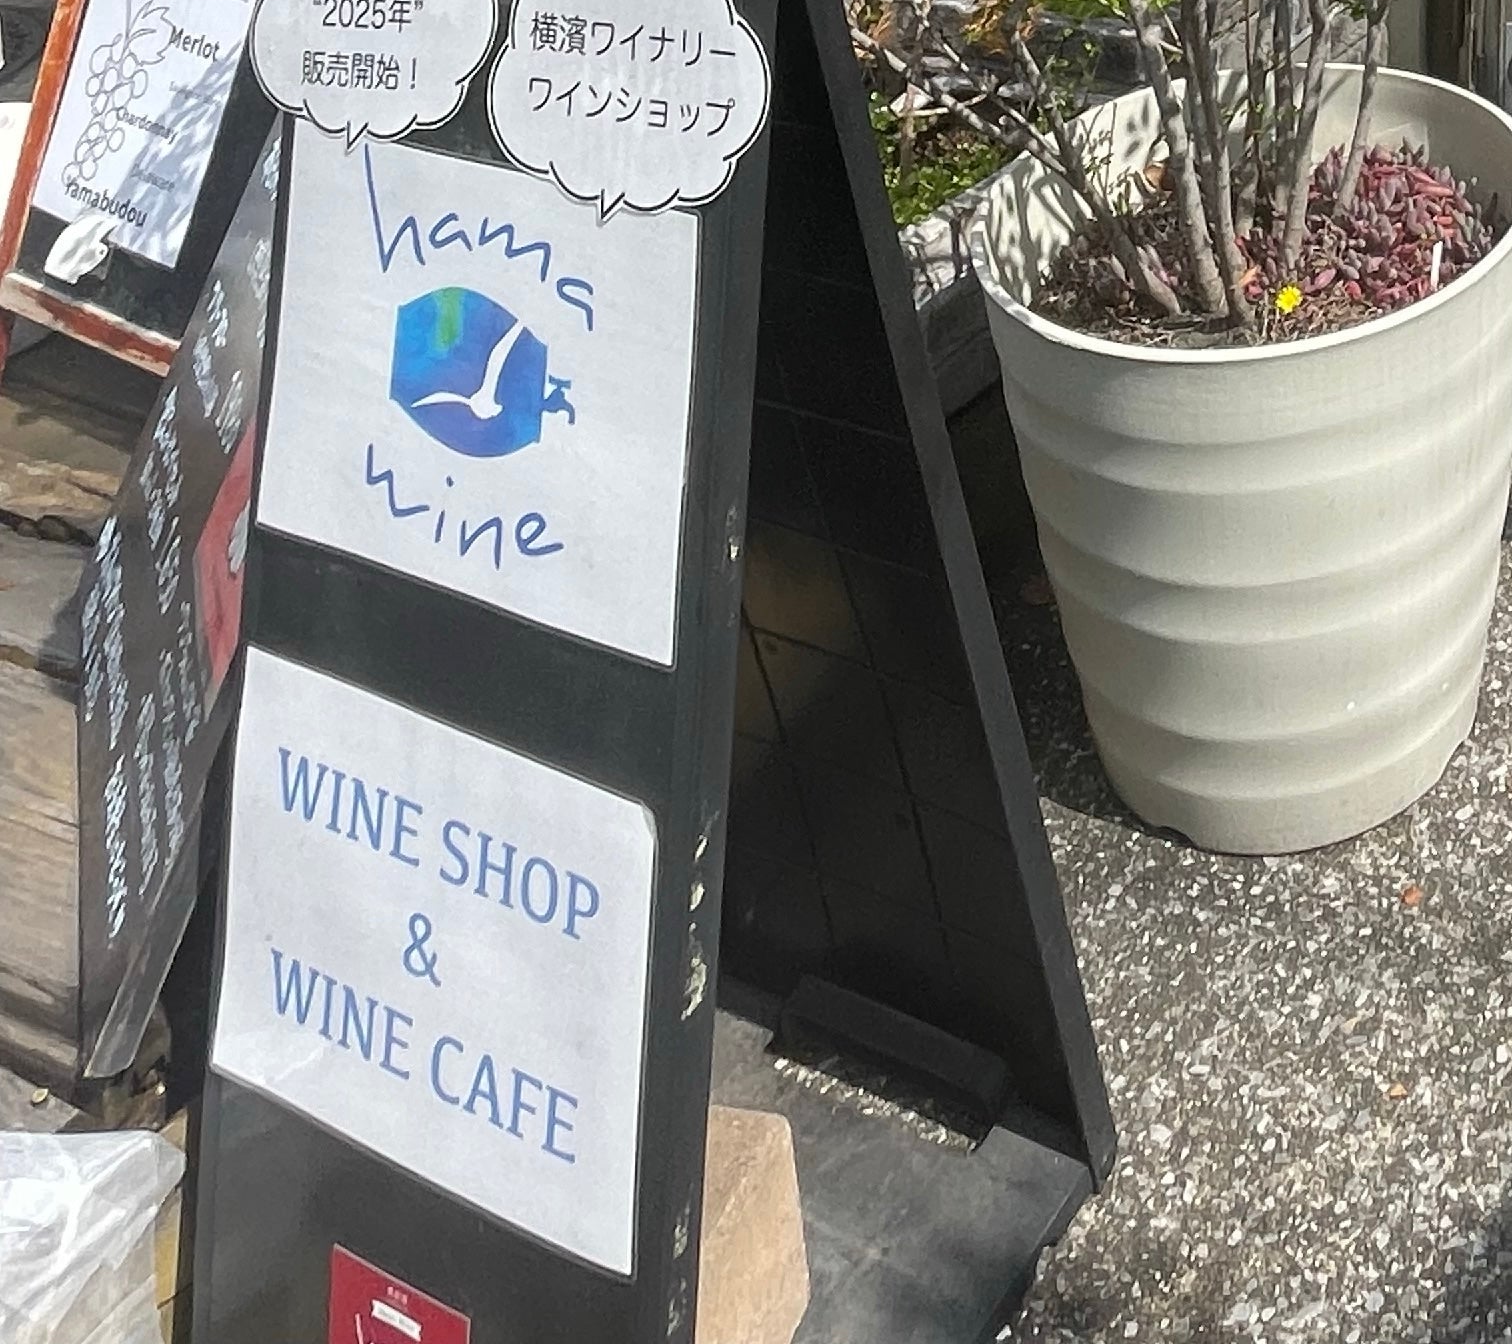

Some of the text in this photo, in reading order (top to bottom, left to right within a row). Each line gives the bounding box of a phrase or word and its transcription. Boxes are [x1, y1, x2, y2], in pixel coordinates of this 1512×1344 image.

[168, 24, 221, 61] Merlot
[528, 12, 737, 70] 横濱ワイナリー
[528, 77, 736, 138] ワインショップ
[63, 174, 148, 228] Yamabudou
[363, 143, 594, 332] hama
[364, 442, 564, 571] wine
[277, 746, 601, 942] WINE SHOP
[402, 912, 442, 988] &
[270, 947, 579, 1165] WINE CAFE
